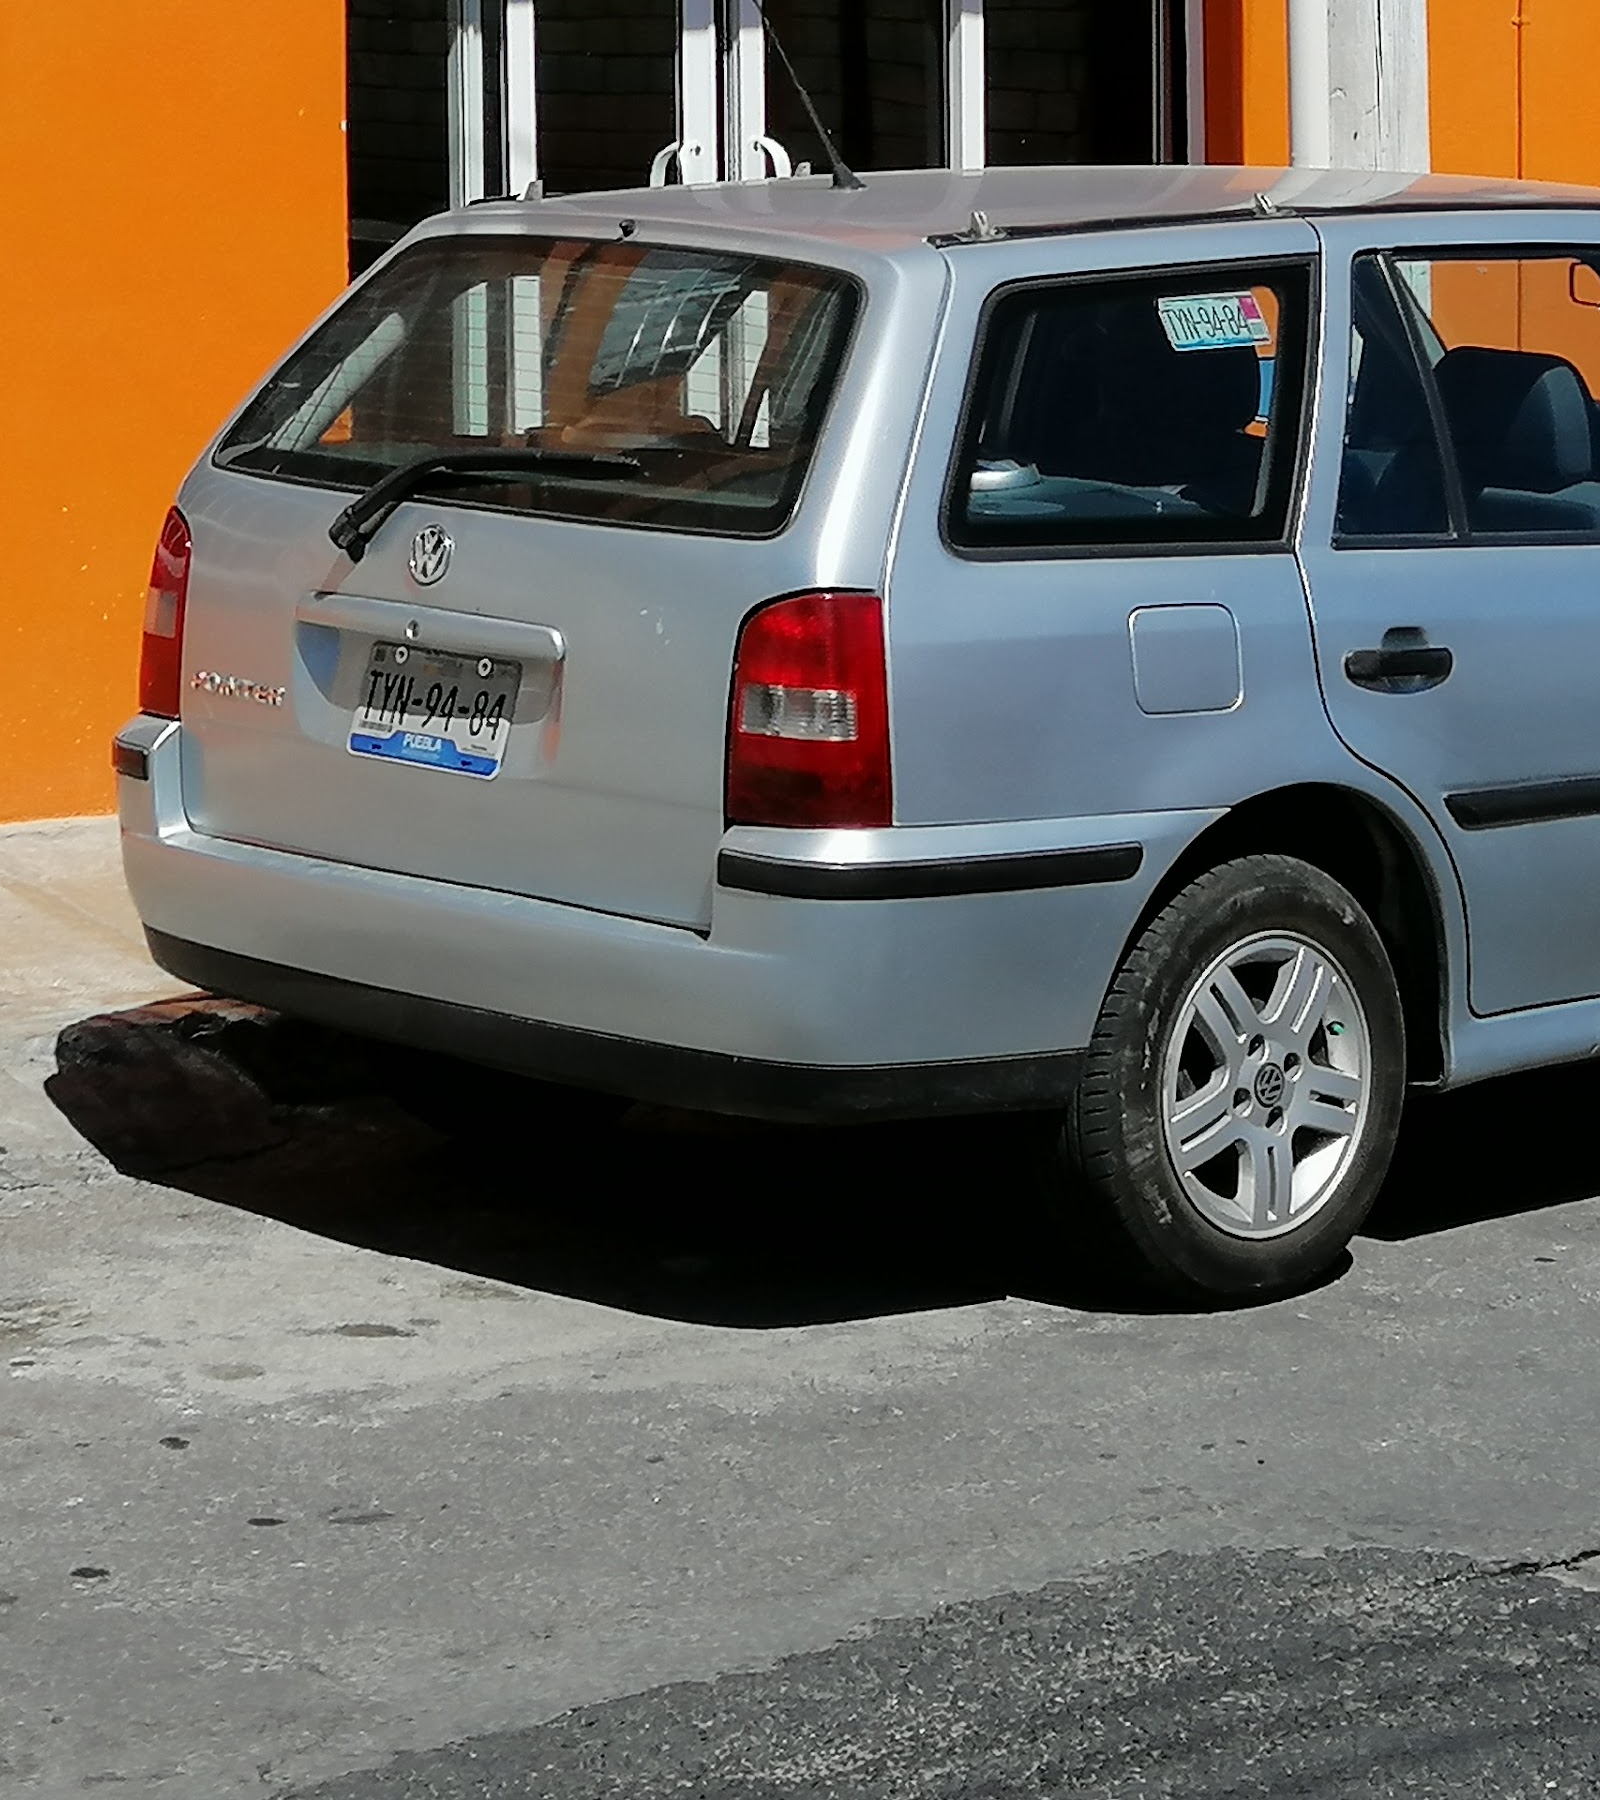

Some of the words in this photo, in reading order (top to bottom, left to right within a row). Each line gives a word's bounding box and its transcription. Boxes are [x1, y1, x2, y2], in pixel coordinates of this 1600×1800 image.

[1161, 304, 1253, 340] TYN-94-84
[364, 670, 507, 742] TYN-94-84
[402, 733, 443, 751] PUEBLA
